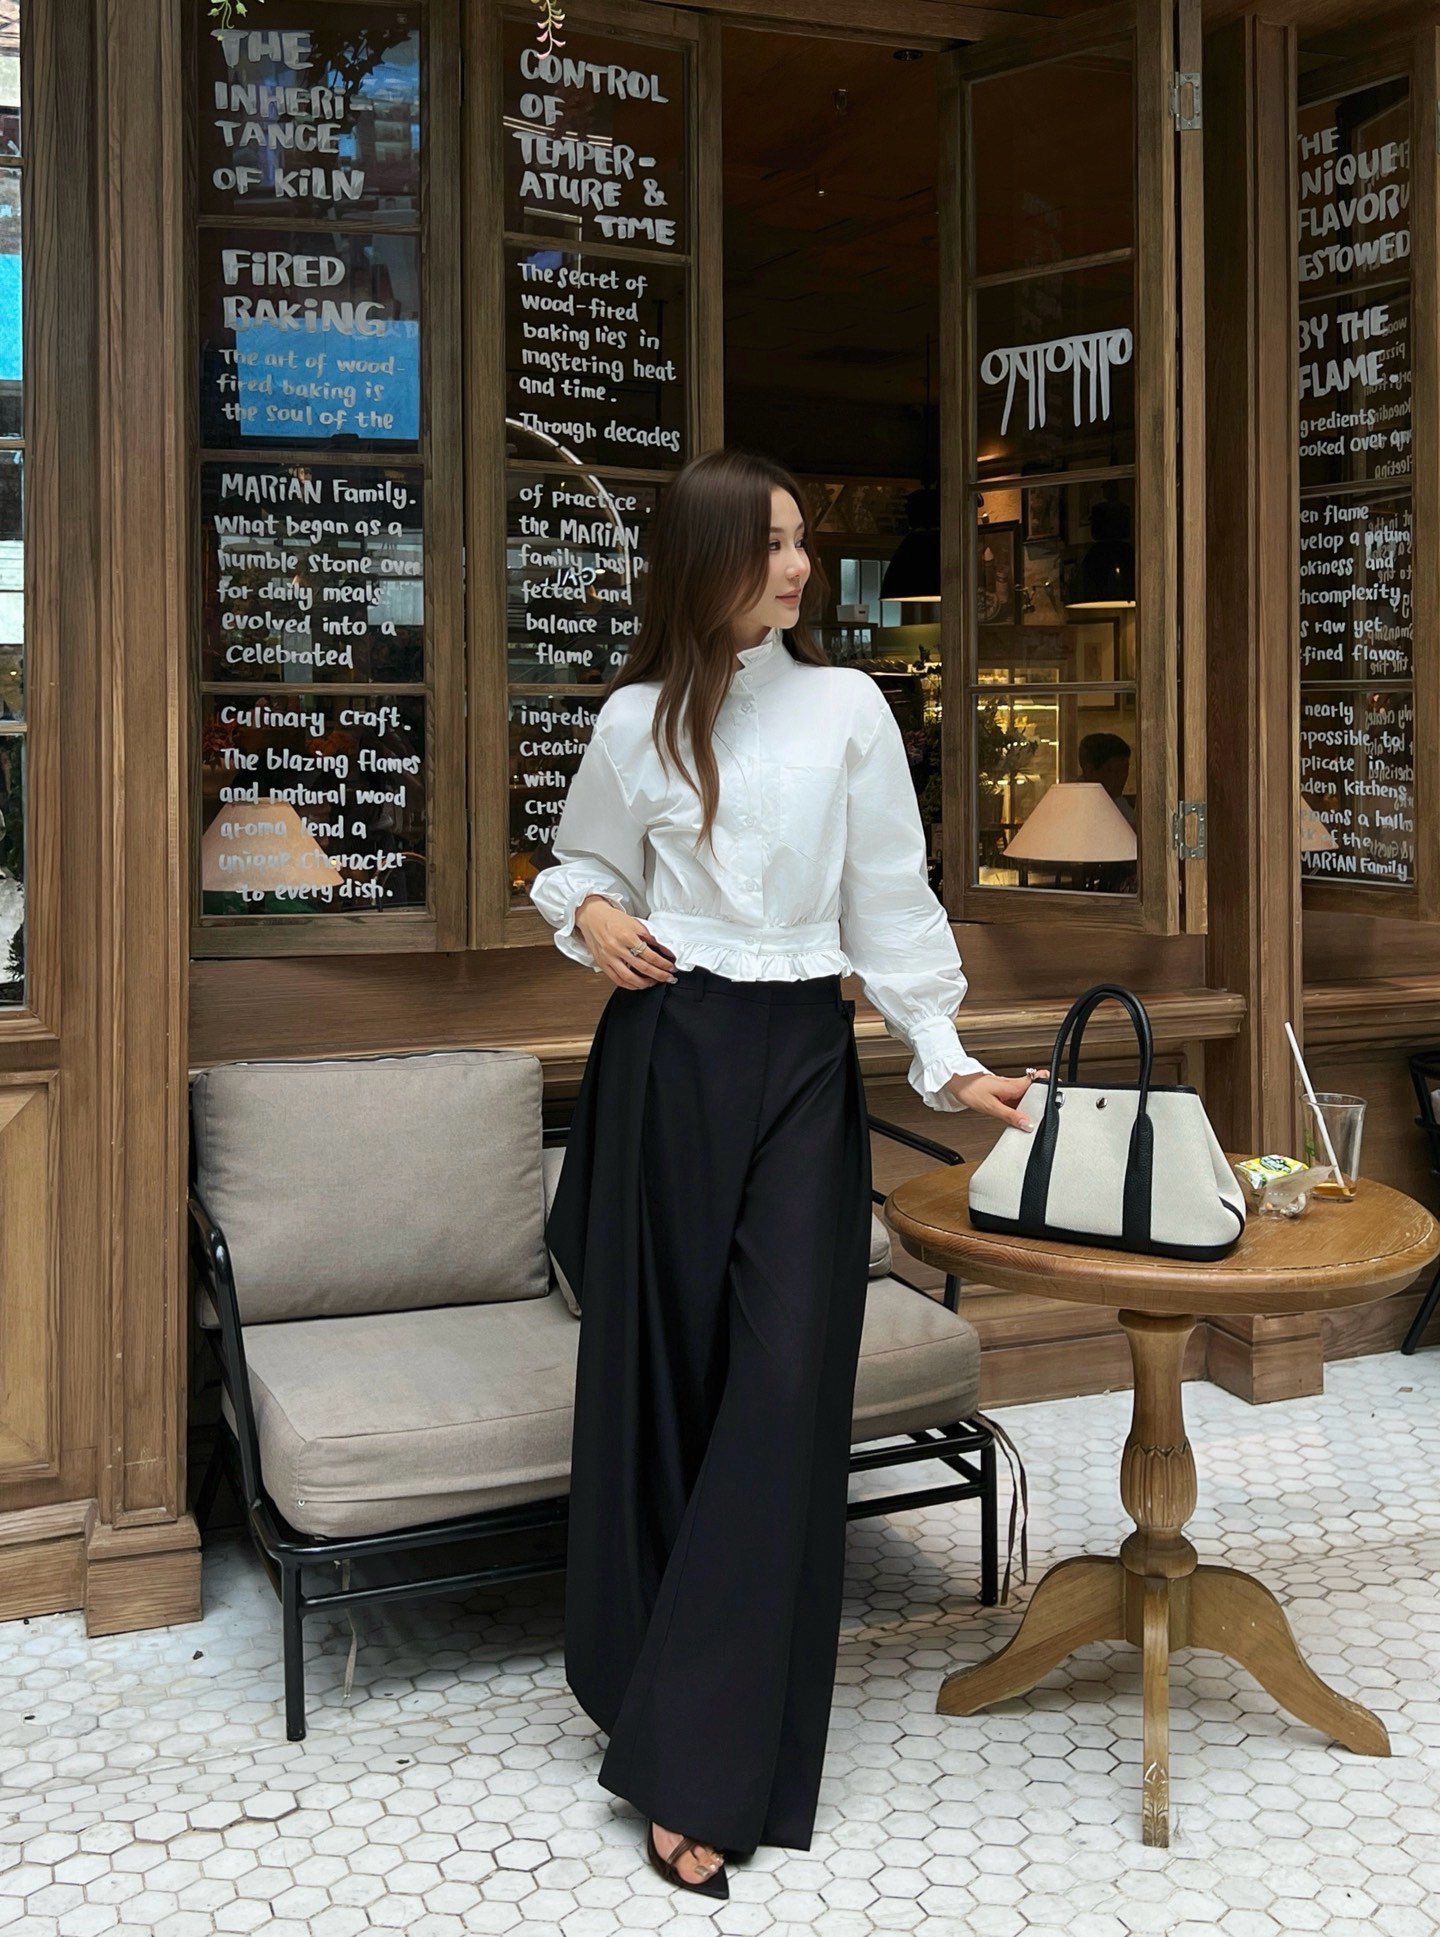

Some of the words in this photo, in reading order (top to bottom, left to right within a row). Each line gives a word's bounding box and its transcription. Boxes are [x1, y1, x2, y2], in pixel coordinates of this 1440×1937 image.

[210, 29, 314, 70] THE
[520, 48, 669, 103] CONTROL
[520, 93, 565, 126] OF
[214, 120, 342, 154] TANCE
[1297, 126, 1340, 160] HE
[212, 166, 262, 194] OF
[519, 170, 622, 211] ATURE
[643, 179, 668, 206] &
[517, 262, 553, 283] The
[625, 275, 648, 298] of
[521, 294, 638, 322] wood-fired
[523, 322, 589, 350] baking
[596, 325, 627, 349] lies
[640, 329, 659, 349] in
[1299, 313, 1328, 353] BY
[1336, 305, 1389, 345] THE
[218, 349, 258, 367] The
[264, 351, 298, 369] art
[305, 353, 327, 378] of
[522, 349, 624, 382] mastering
[633, 359, 676, 381] heat
[216, 373, 273, 395] fired
[283, 379, 356, 408] baking
[365, 381, 384, 401] is
[519, 376, 554, 397] and
[221, 402, 258, 422] the
[319, 409, 347, 430] of
[354, 411, 393, 429] the
[519, 412, 597, 443] Through
[604, 420, 680, 452] decades
[1350, 433, 1387, 452] over
[332, 479, 416, 509] Family.
[520, 484, 543, 508] of
[519, 515, 549, 538] the
[1324, 504, 1369, 526] flame
[214, 514, 279, 536] What
[286, 516, 348, 544] began
[355, 519, 381, 537] as
[388, 522, 402, 537] a
[1301, 532, 1344, 554] velop
[1350, 531, 1360, 547] a
[217, 549, 298, 573] humble
[519, 544, 583, 576] family
[595, 553, 625, 574] has
[1365, 555, 1394, 571] and
[217, 579, 253, 603] for
[258, 582, 312, 610] daily
[323, 584, 384, 606] meals
[521, 580, 587, 603] fected
[598, 585, 632, 605] and
[222, 611, 311, 635] evolved
[322, 615, 366, 636] into
[381, 620, 397, 636] a
[526, 613, 598, 634] balance
[1315, 619, 1346, 633] raw
[1353, 616, 1383, 639] yet
[536, 643, 593, 667] flame
[1352, 644, 1404, 662] flavor
[1305, 702, 1354, 725] nearly
[1381, 731, 1400, 748] to
[220, 748, 259, 770] The
[266, 748, 348, 778] blazing
[357, 749, 421, 774] flames
[523, 771, 565, 788] with
[1344, 780, 1407, 800] kitchens
[219, 782, 258, 804] and
[270, 783, 346, 807] natural
[356, 785, 406, 808] wood
[220, 820, 286, 839] aroma
[301, 815, 344, 839] lend
[352, 821, 366, 839] a
[1358, 814, 1370, 828] a
[1342, 832, 1371, 850] the
[219, 851, 291, 873] unique
[300, 850, 406, 871] character
[1360, 857, 1408, 882] Family
[236, 885, 264, 902] to
[275, 883, 333, 903] every
[339, 879, 393, 899] dish.
